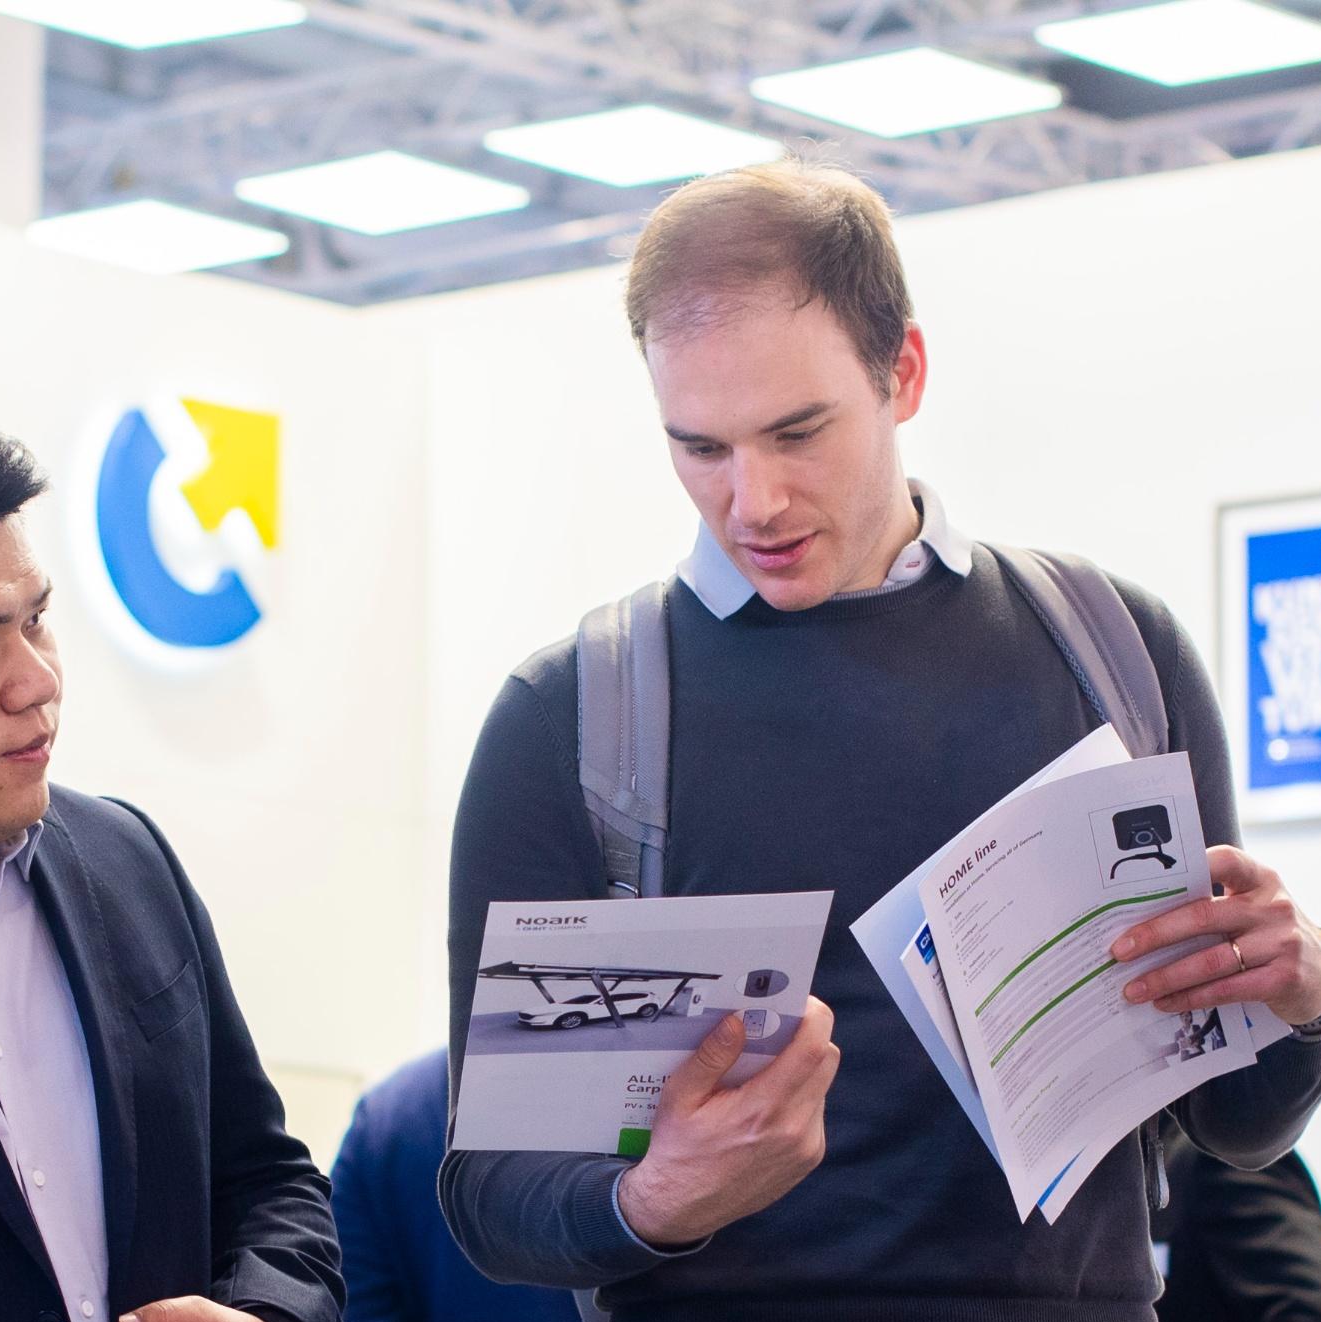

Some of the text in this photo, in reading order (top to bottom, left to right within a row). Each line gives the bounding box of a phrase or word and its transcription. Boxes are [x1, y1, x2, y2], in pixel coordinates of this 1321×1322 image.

[939, 839, 998, 899] HOME line
[627, 1075, 671, 1083] ALL-I
